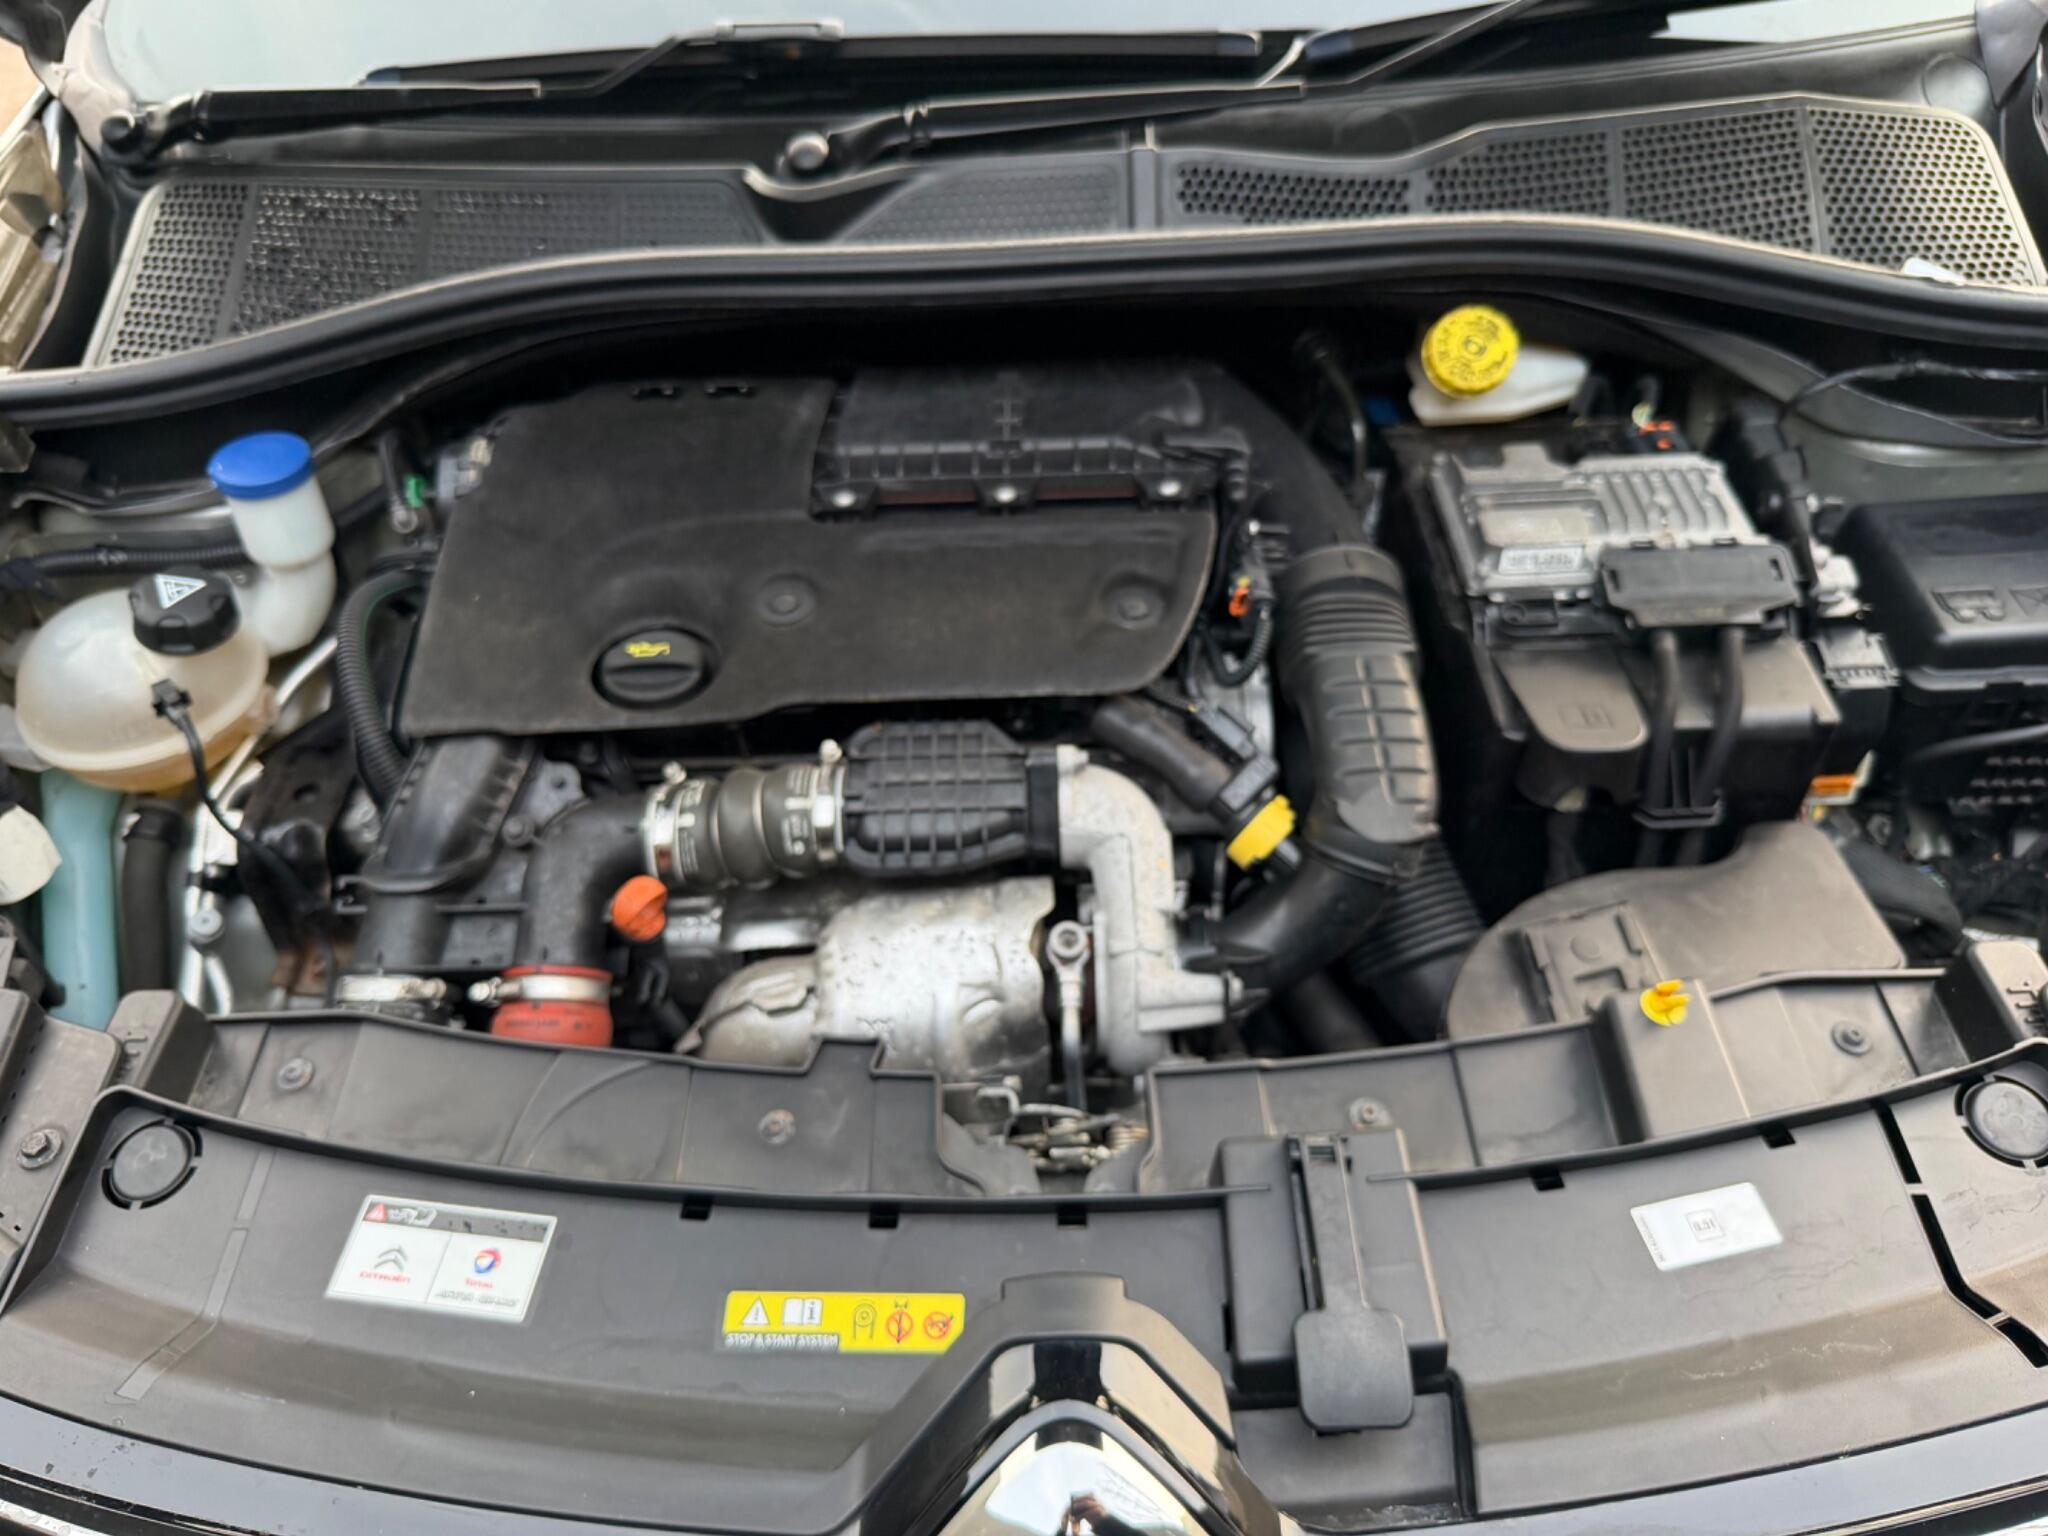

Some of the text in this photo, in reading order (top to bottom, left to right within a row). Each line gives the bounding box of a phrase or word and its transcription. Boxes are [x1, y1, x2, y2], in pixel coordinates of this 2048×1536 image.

[726, 1333, 755, 1346] STOP
[765, 1333, 797, 1346] START
[798, 1333, 839, 1346] SYSTEM
